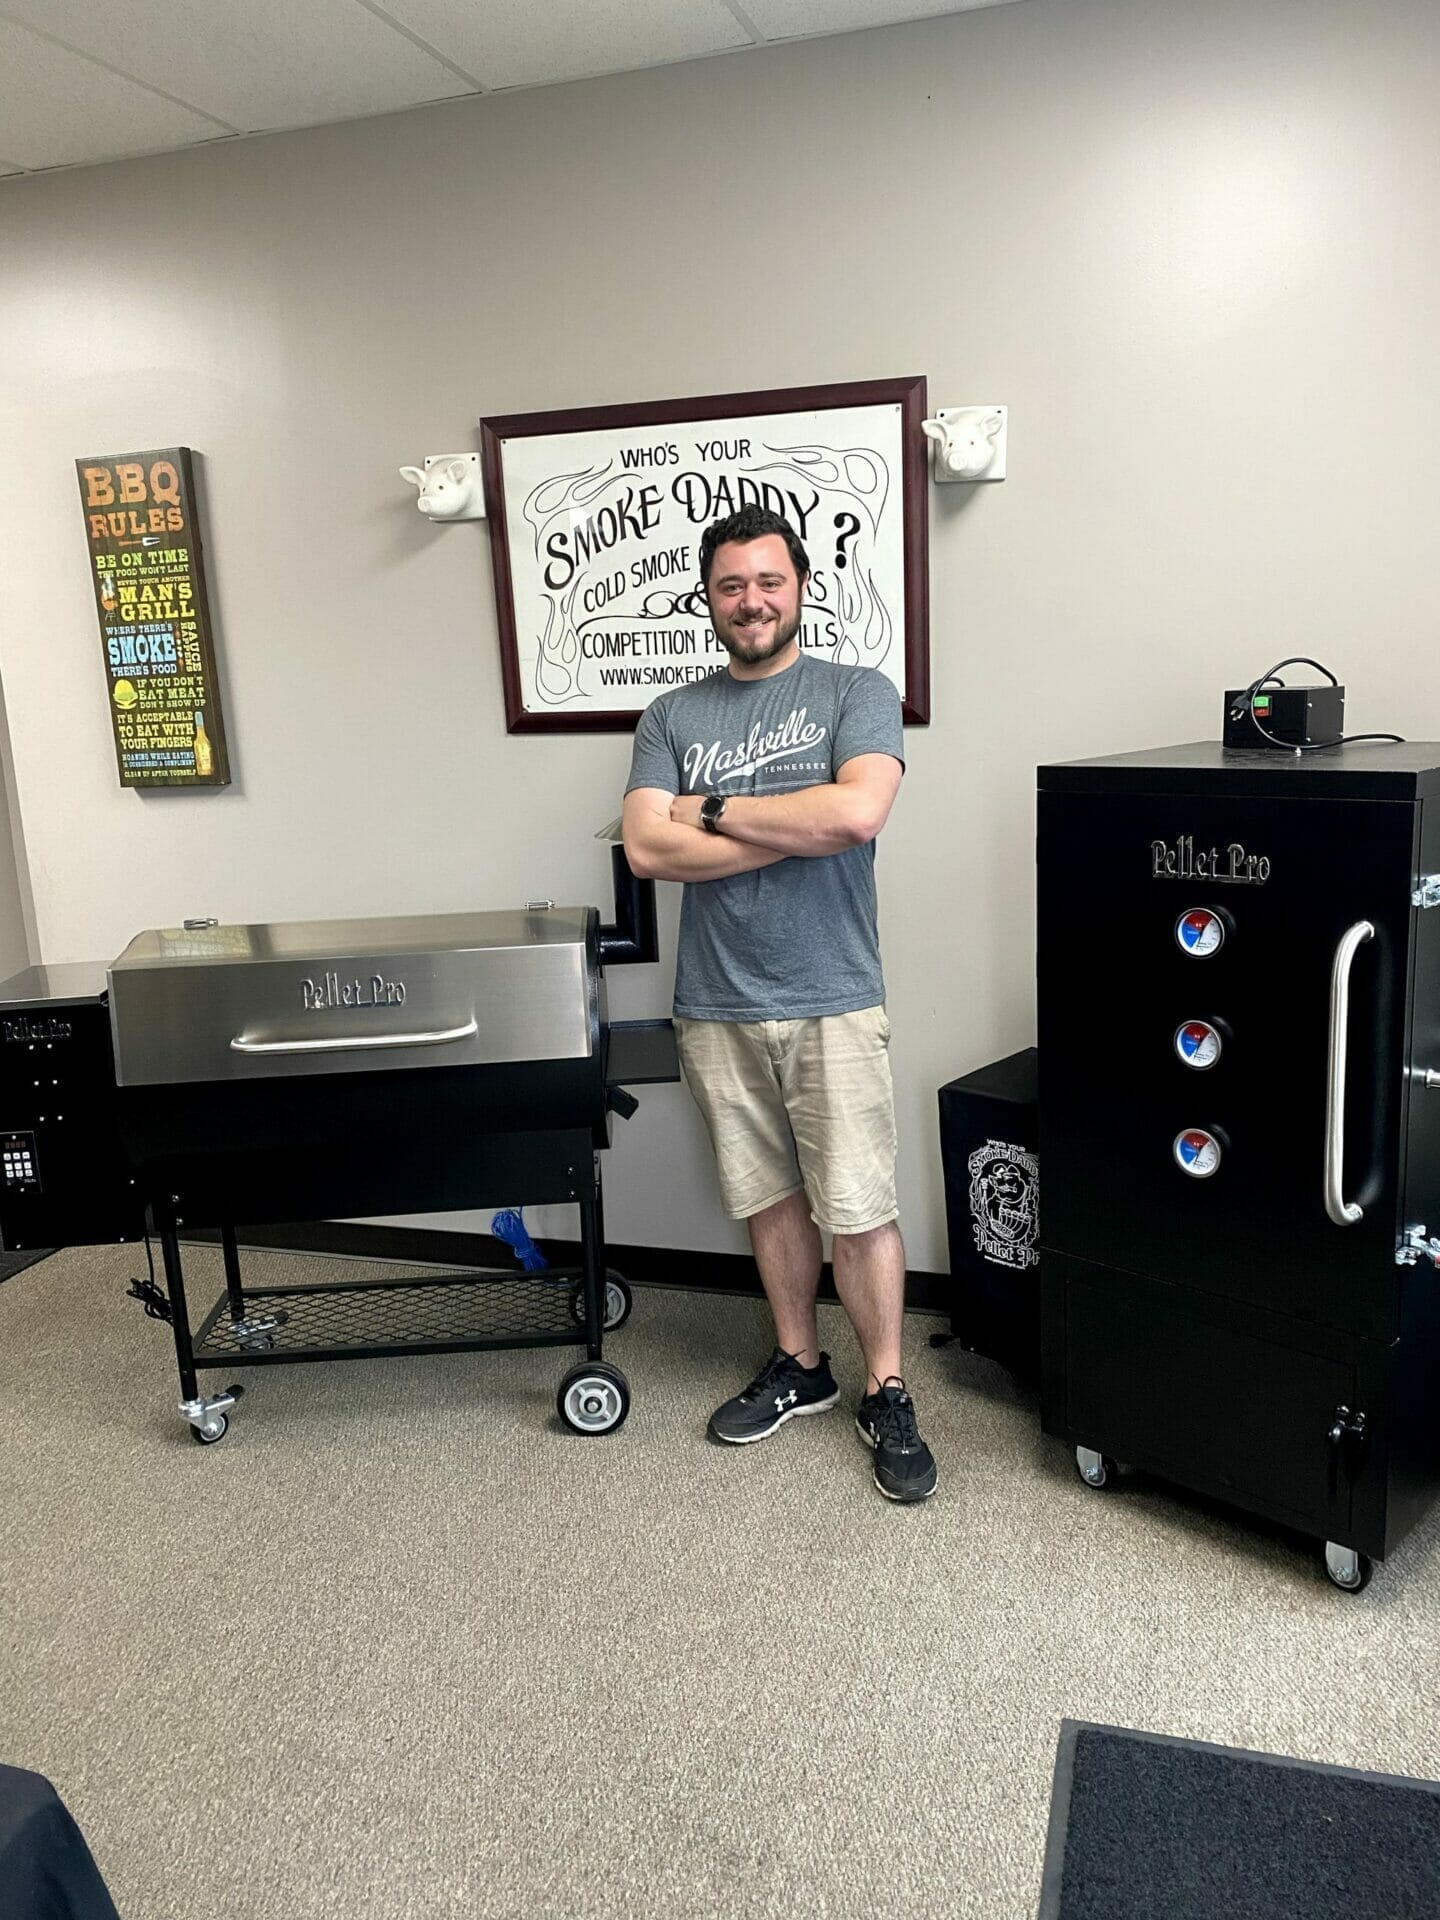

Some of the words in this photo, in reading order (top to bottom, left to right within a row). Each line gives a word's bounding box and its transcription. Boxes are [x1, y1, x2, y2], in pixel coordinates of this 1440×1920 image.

[619, 442, 679, 469] WHO'S
[695, 439, 752, 462] YOUR
[83, 461, 181, 507] BBQ
[89, 507, 184, 539] RULES
[544, 484, 665, 591] SMOKE
[671, 471, 820, 541] DADDY
[95, 554, 117, 569] BE
[121, 552, 143, 567] ON
[148, 548, 189, 565] TIME
[115, 568, 138, 577] FOOD
[139, 565, 166, 575] WON'T
[167, 564, 189, 573] LAST
[139, 577, 160, 585] TOUCH
[161, 575, 191, 583] ANOTHER
[583, 570, 626, 613] COLD
[630, 545, 691, 588] SMOKE
[118, 582, 193, 604] MAN'S
[121, 600, 196, 622] GRILL
[105, 625, 136, 636] WHERE
[138, 622, 173, 634] THERE'S
[107, 633, 177, 666] SMOKE
[180, 622, 193, 673] HAPPENS
[187, 621, 202, 672] SAUCE
[582, 629, 696, 659] COMPETITION
[111, 664, 149, 677] THERE'S
[152, 664, 177, 675] FOOD
[136, 679, 148, 688] IF
[149, 678, 171, 688] YOU
[173, 675, 203, 687] DON'T
[138, 688, 164, 701] EAT
[167, 687, 204, 699] MEAT
[140, 700, 164, 709] DON'T
[166, 699, 192, 708] SHOW
[194, 698, 206, 707] UP
[117, 712, 133, 724] IT'S
[136, 711, 194, 723] ACCEPTABLE
[118, 725, 134, 738] TO
[136, 724, 159, 737] EAT
[161, 722, 195, 736] WITH
[120, 738, 149, 750] YOUR
[149, 736, 193, 749] FINGERS
[683, 707, 826, 790] Nashville
[764, 762, 827, 774] TENNESSEE
[1150, 834, 1219, 880] Pellet
[1226, 843, 1271, 884] Pro
[301, 971, 362, 1009] Pellet
[370, 974, 406, 1007] Pro
[1008, 1149, 1039, 1177] DADD
[973, 1223, 1014, 1261] Pellet
[1016, 1247, 1040, 1267] Pr
